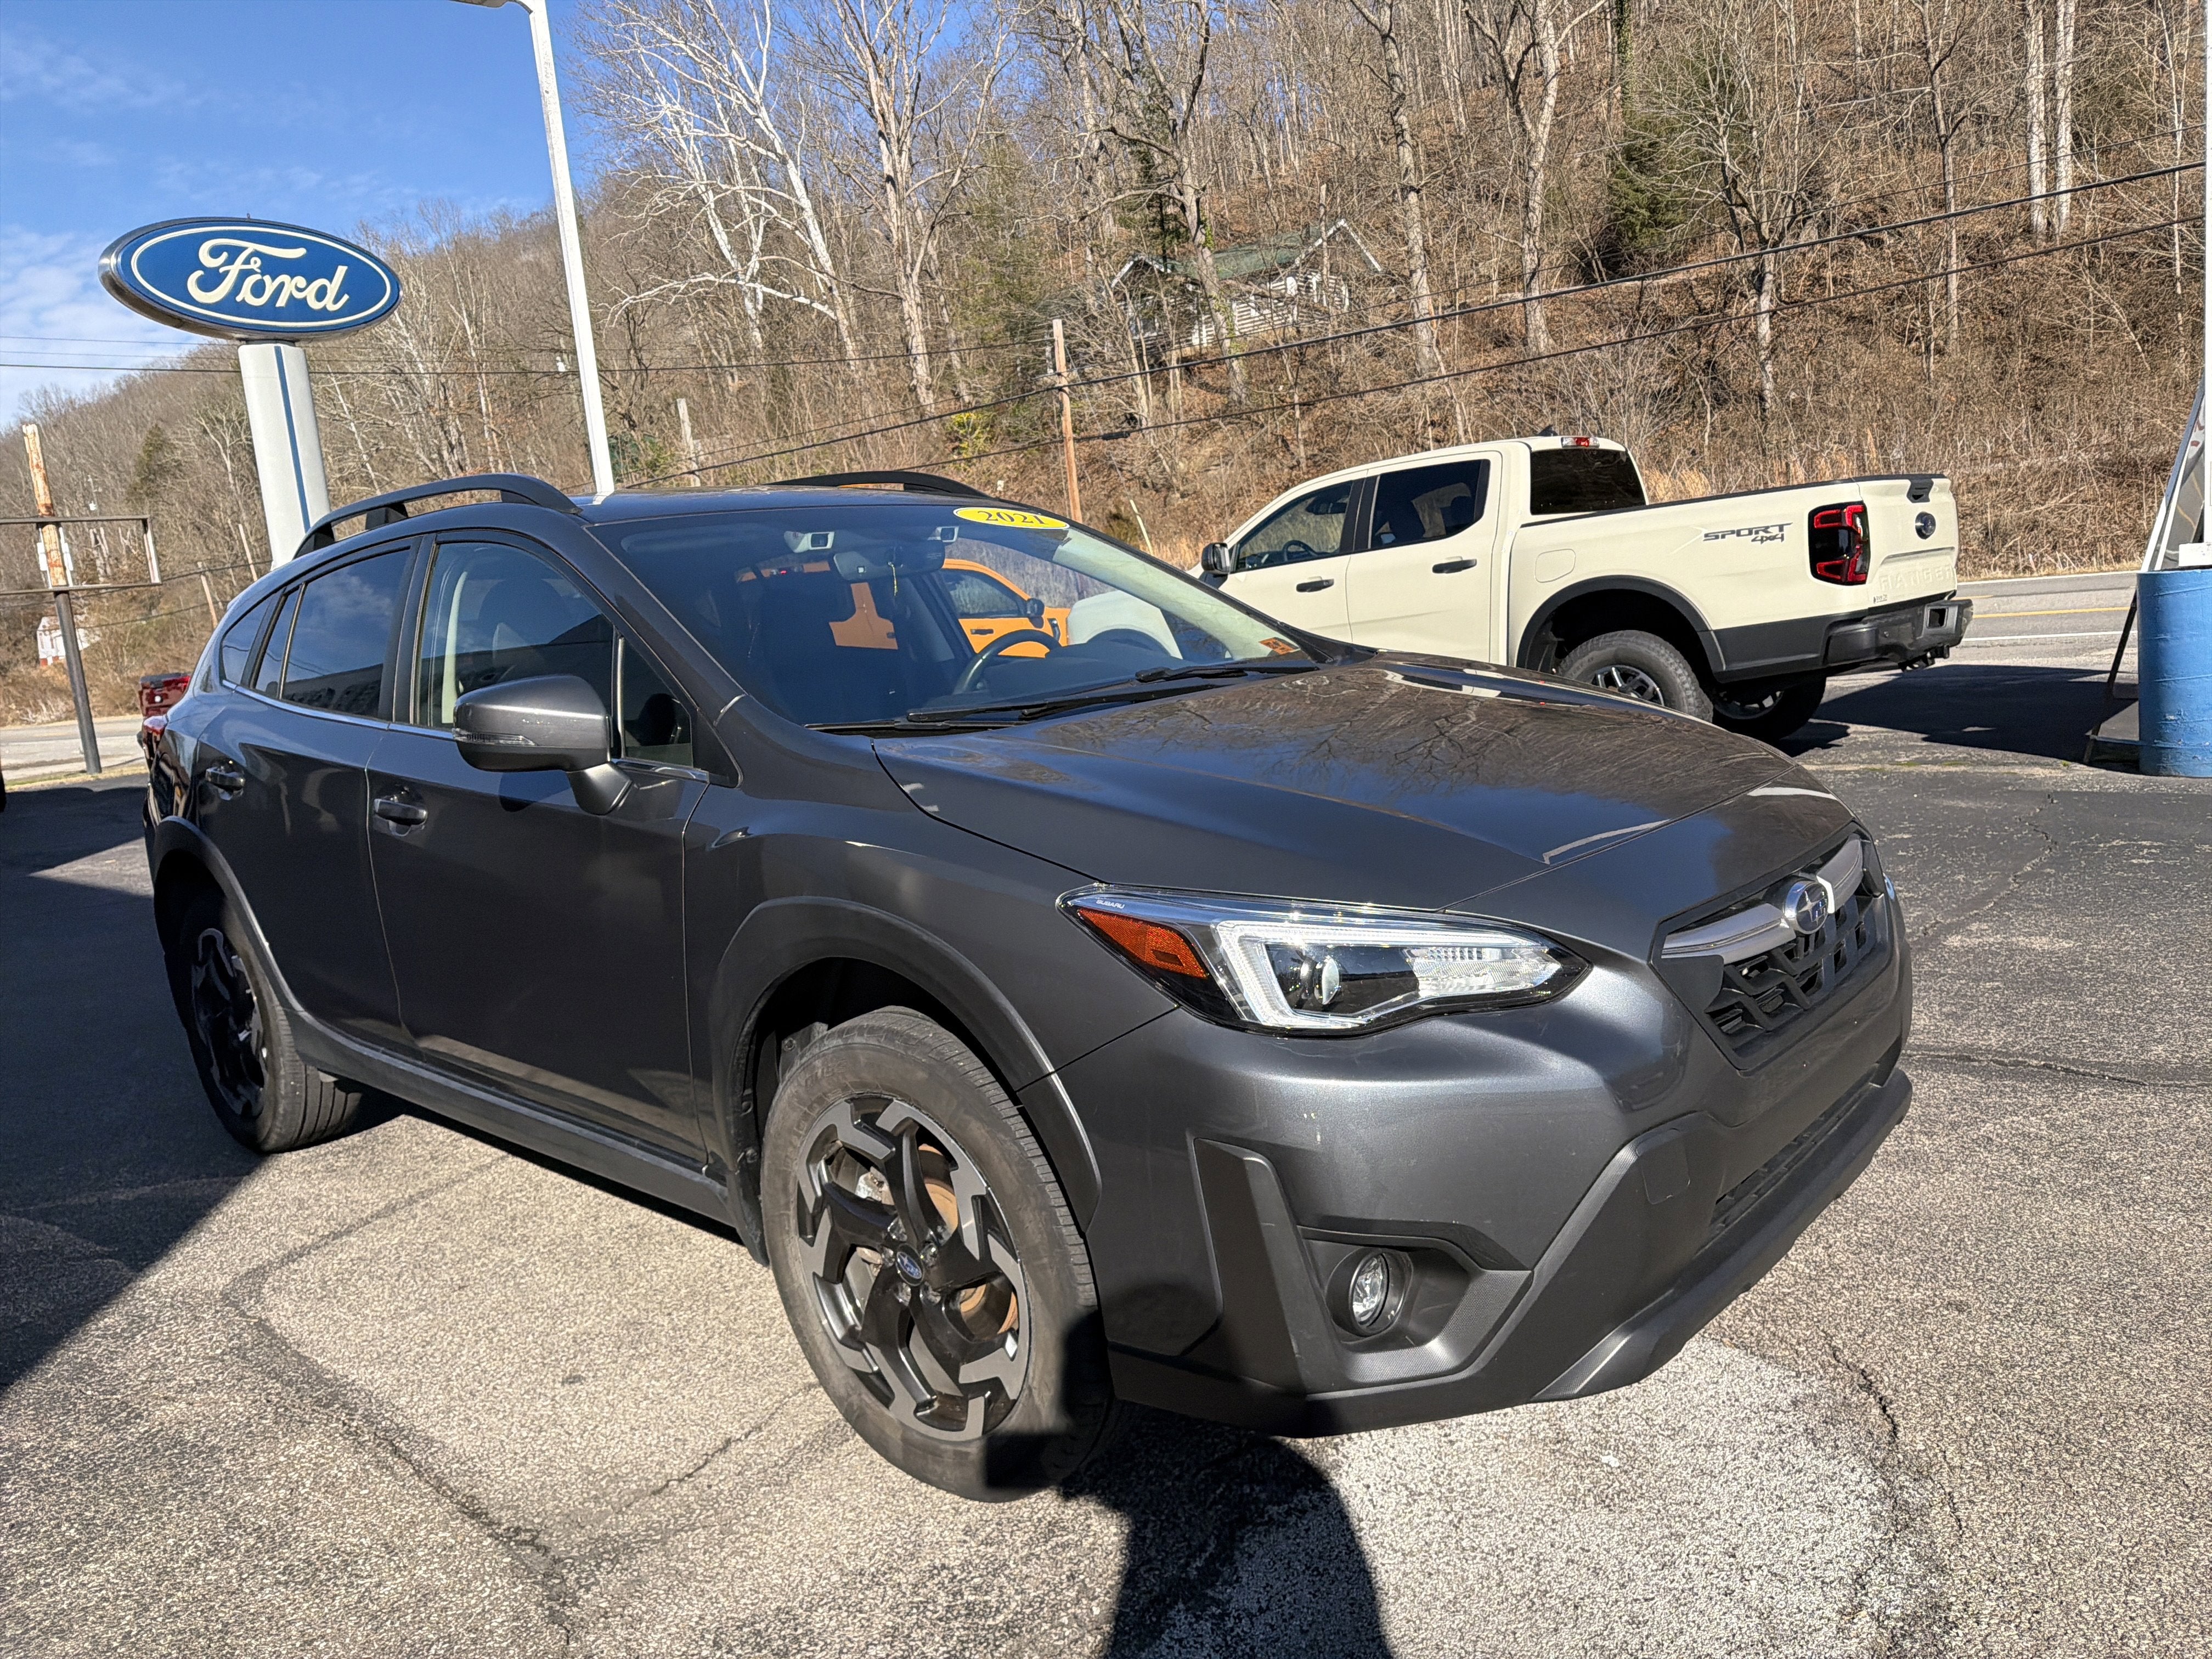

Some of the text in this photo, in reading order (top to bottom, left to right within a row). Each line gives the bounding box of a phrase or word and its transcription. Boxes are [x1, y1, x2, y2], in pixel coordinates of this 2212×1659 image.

[187, 238, 349, 312] Ford
[977, 510, 1049, 525] 2021
[1702, 522, 1793, 541] SPORT
[1879, 565, 1954, 591] RANGER
[1096, 899, 1125, 909] SUBARU
